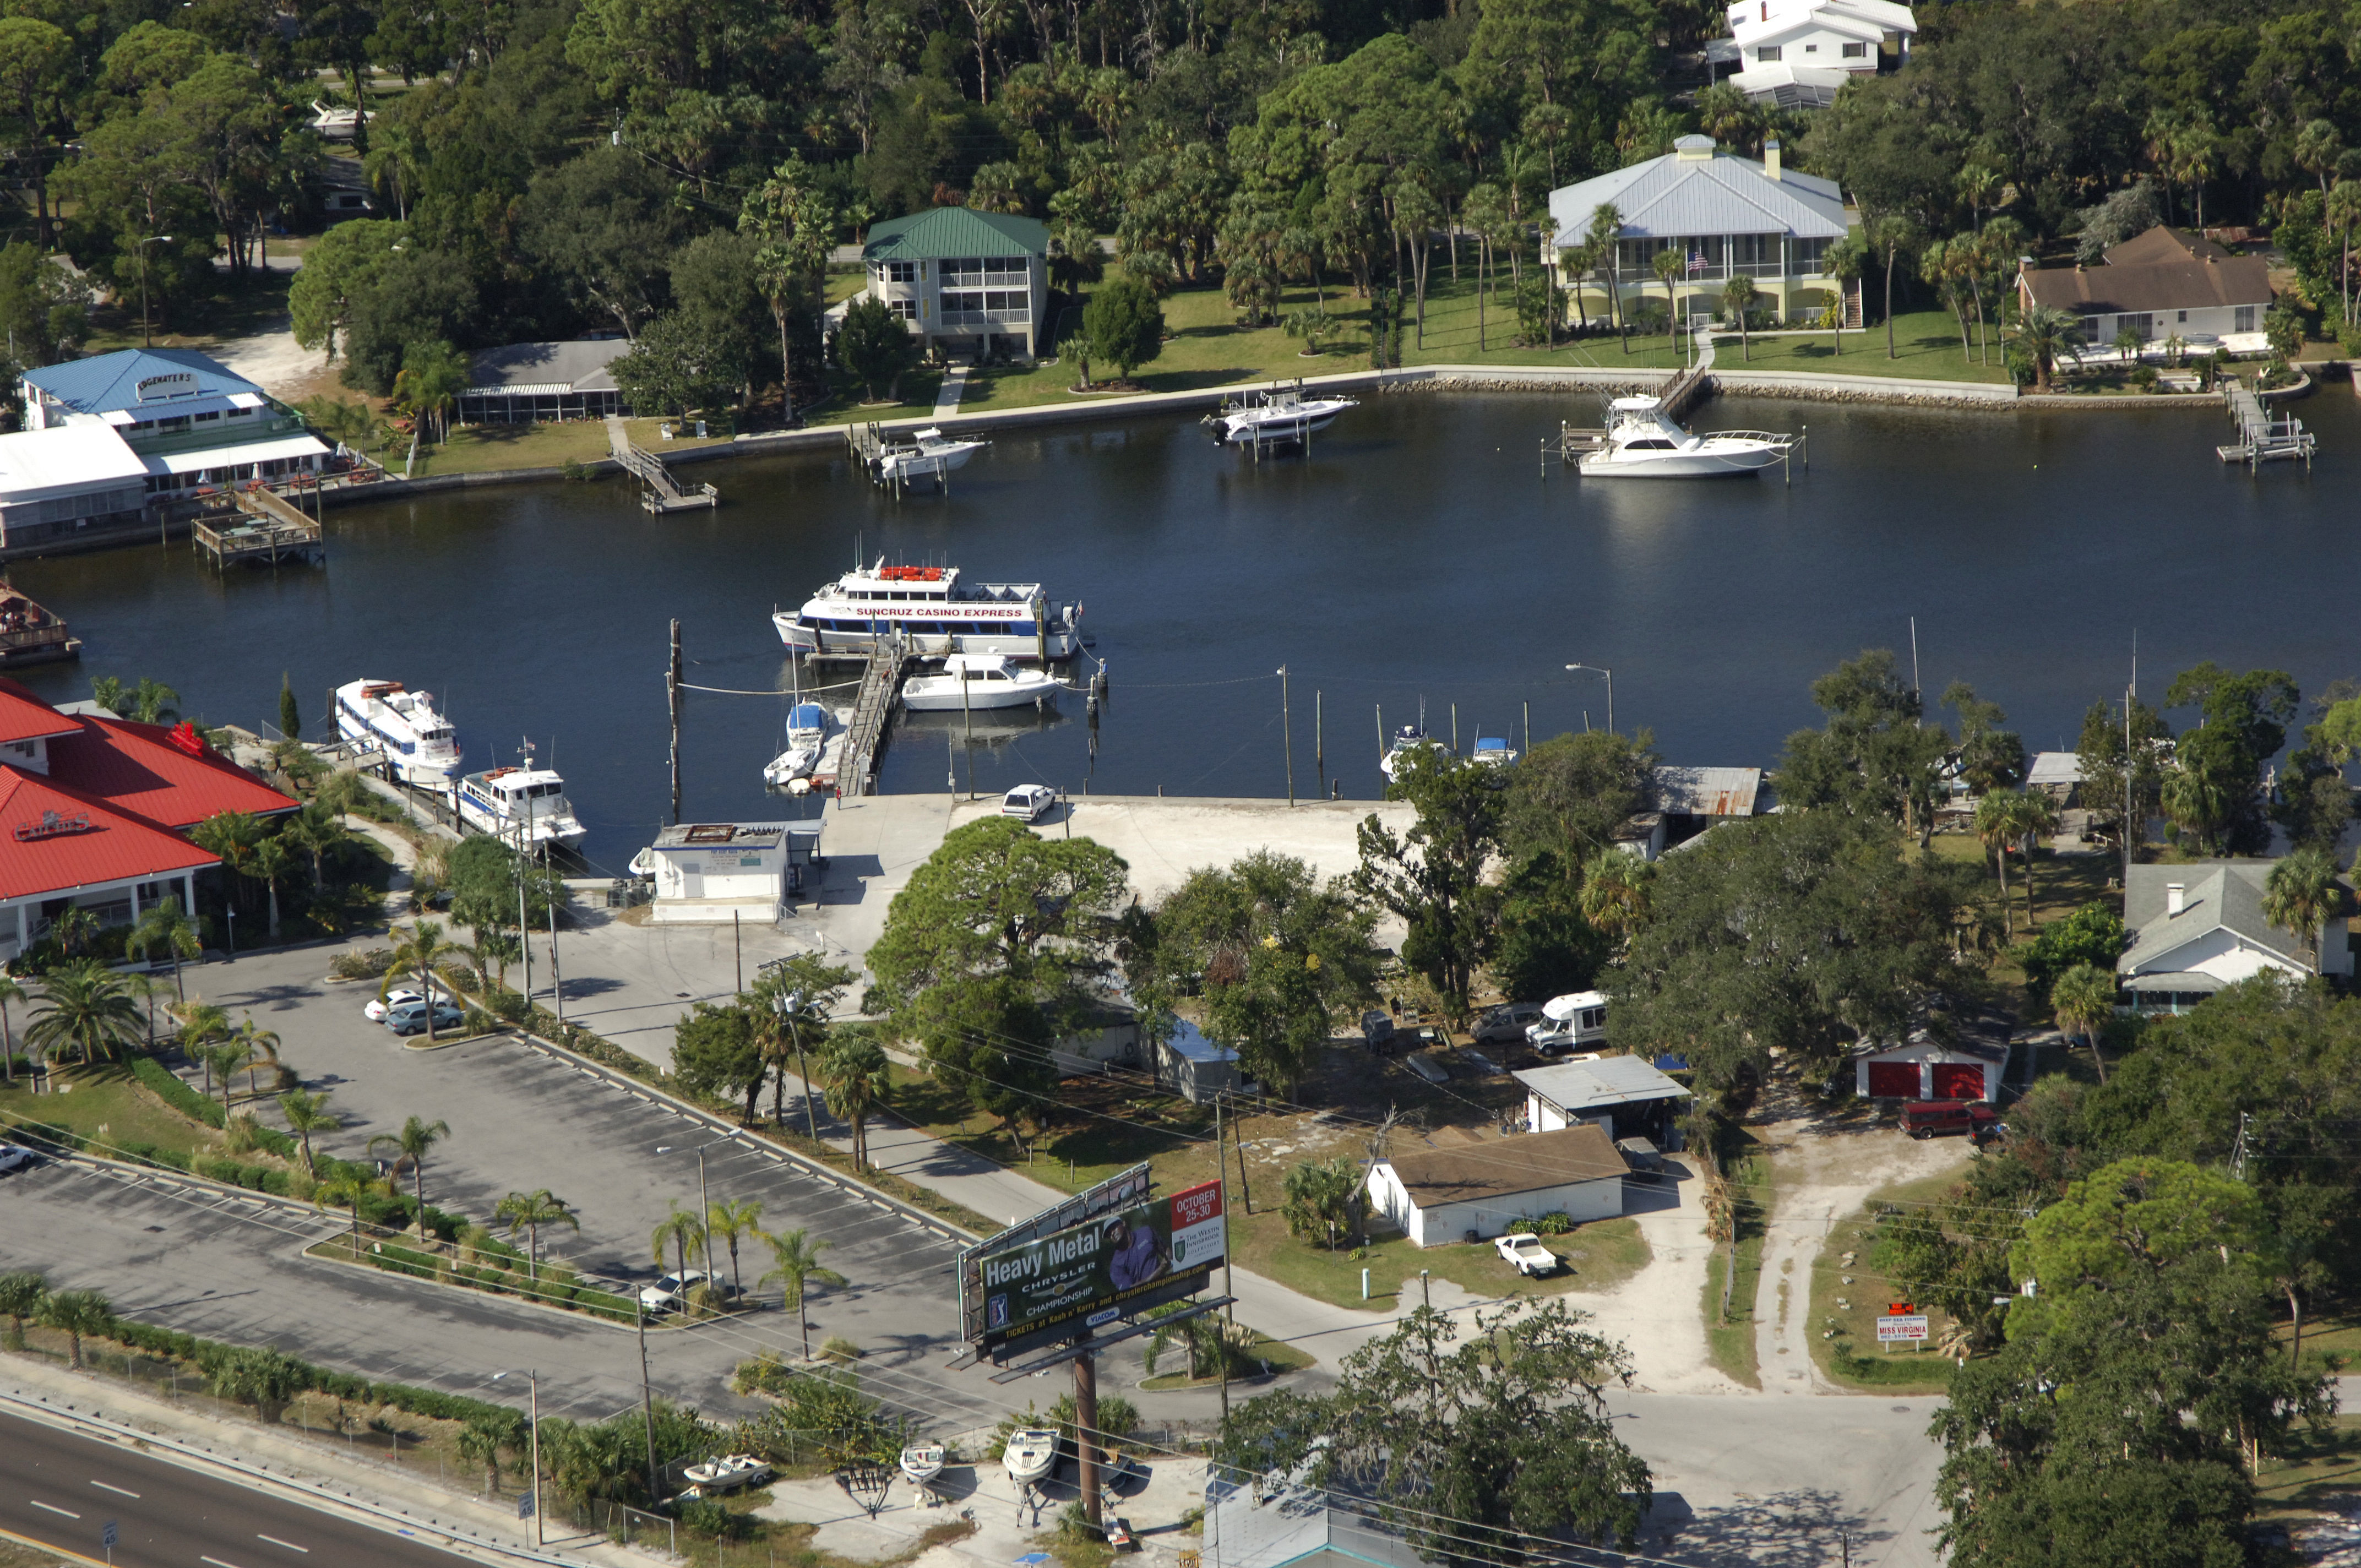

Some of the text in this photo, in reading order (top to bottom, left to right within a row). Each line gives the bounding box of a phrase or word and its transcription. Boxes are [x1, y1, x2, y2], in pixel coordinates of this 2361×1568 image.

[138, 374, 191, 391] EDGEWATERS
[964, 609, 1022, 617] EXPRESS
[14, 813, 89, 841] CATCHES
[1177, 1189, 1216, 1213] OCTOBER
[1186, 1205, 1210, 1223] 25-30
[1198, 1226, 1220, 1238] WESTIN
[1186, 1233, 1220, 1249] INNISBROOK
[986, 1227, 1100, 1287] Heavy Metal
[1022, 1262, 1096, 1293] CHRYSLER
[1005, 1323, 1035, 1339] TICKETS
[1038, 1317, 1046, 1328] at
[1049, 1313, 1066, 1325] Kash
[1077, 1301, 1096, 1314] Karry
[1100, 1296, 1112, 1306] and
[1116, 1264, 1206, 1301] chryslerchampionship.com
[1026, 1286, 1093, 1316] CHAMPIONSHIP
[1090, 1310, 1116, 1324] VIACOM
[1879, 1325, 1926, 1335] MISS VIRGINIA
[521, 1506, 532, 1515] 45
[105, 1534, 116, 1544] 45
